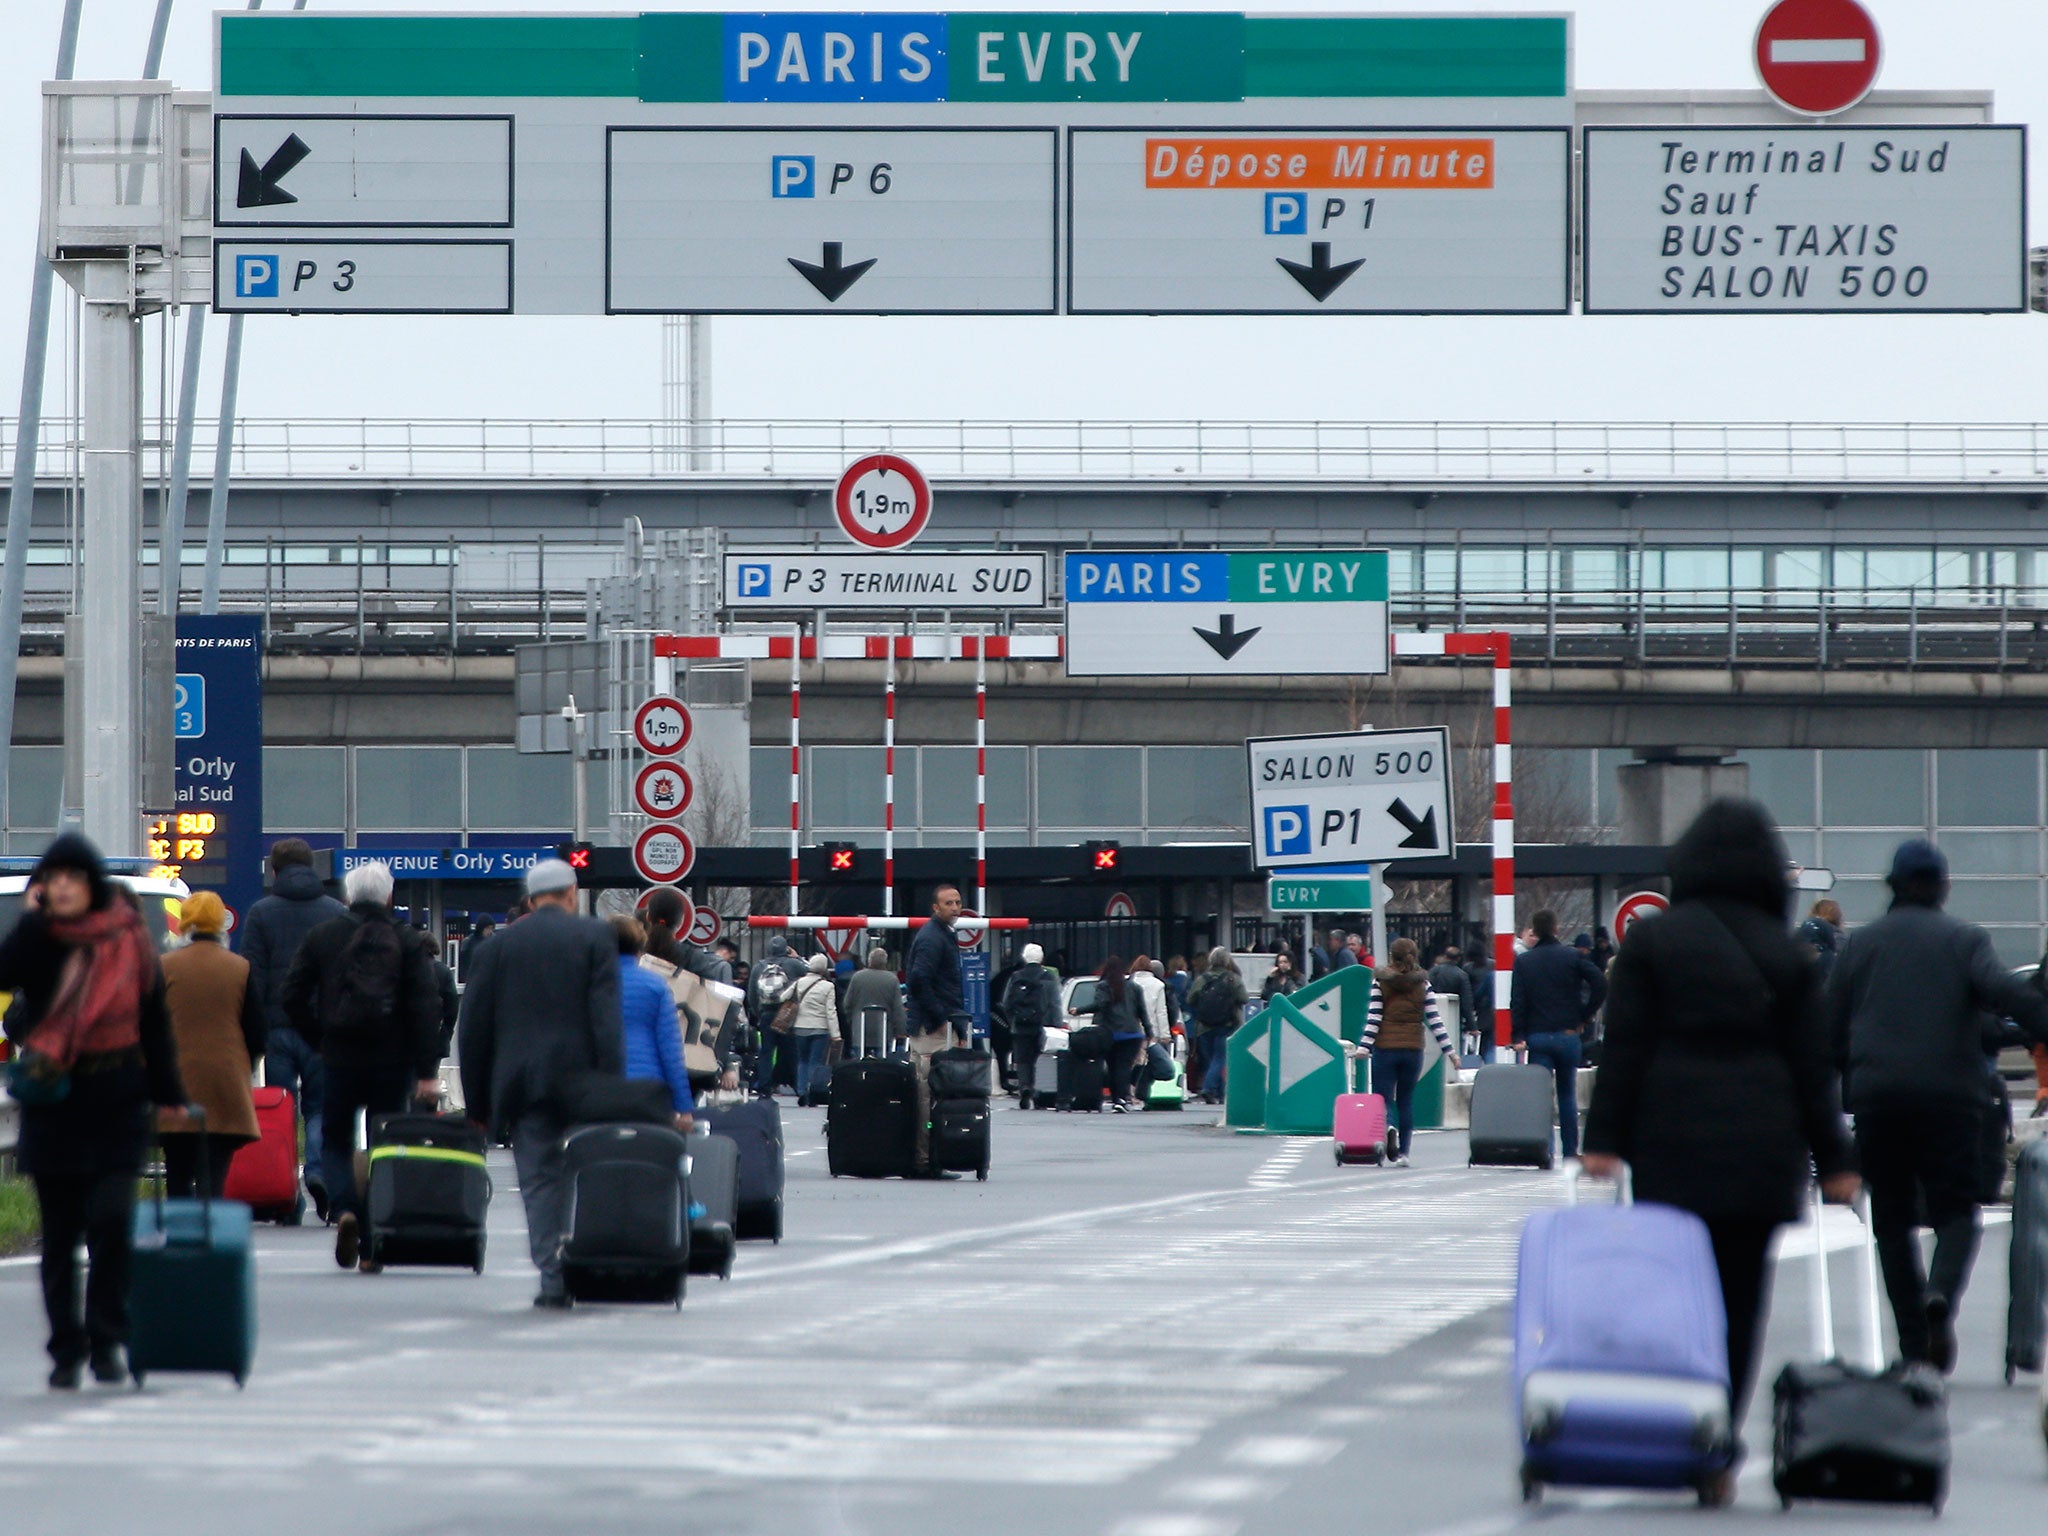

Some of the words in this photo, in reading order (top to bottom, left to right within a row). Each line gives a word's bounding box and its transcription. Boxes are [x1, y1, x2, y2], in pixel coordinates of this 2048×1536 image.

[738, 32, 932, 83] PARIS
[977, 32, 1142, 83] EVRY
[1152, 145, 1308, 186] Dépose
[1333, 145, 1486, 178] Minute
[1660, 141, 1846, 174] Terminal
[1871, 141, 1950, 173] Sud
[1660, 183, 1760, 216] Sauf
[1660, 224, 1898, 257] BUS-TAXIS
[1660, 265, 1810, 298] SALON
[1839, 265, 1929, 298] 500
[855, 490, 911, 518] 1,9m
[840, 572, 958, 593] TERMINAL
[972, 568, 1032, 593] SUD
[1079, 562, 1202, 594] PARIS
[1258, 562, 1361, 593] EVRY
[198, 638, 215, 647] DE
[217, 638, 252, 647] PARIS
[645, 718, 680, 737] 1,9m
[188, 757, 236, 781] Orly
[1262, 755, 1355, 782] SALON
[1375, 751, 1433, 776] 500
[199, 786, 234, 802] Sud
[178, 813, 217, 835] SUD
[1321, 808, 1362, 847] P1
[178, 839, 206, 860] P3
[454, 853, 495, 874] Orly
[502, 853, 537, 870] Sud
[1277, 887, 1320, 902] EVRY
